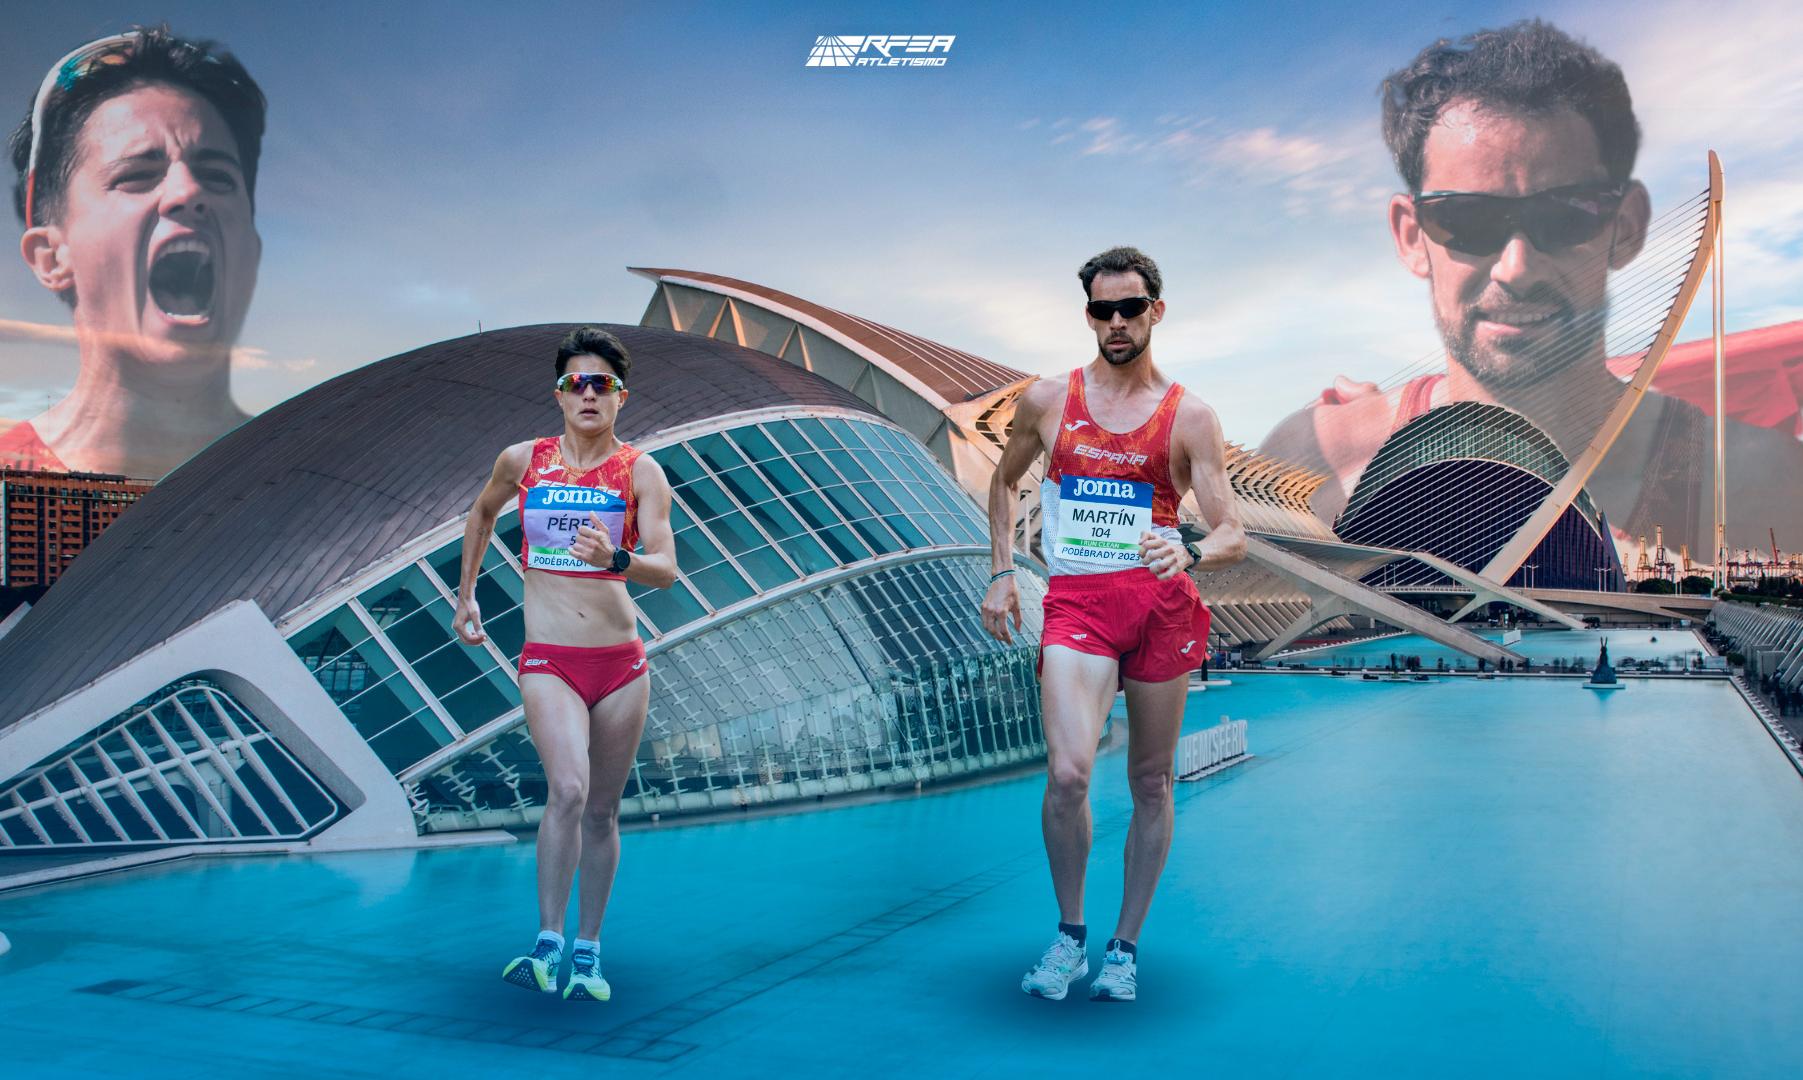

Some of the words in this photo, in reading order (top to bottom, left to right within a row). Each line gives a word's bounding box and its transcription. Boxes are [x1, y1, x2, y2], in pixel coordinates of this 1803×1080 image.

[1073, 444, 1148, 465] ESPAÑA
[547, 514, 602, 531] PÉRE
[1072, 508, 1136, 527] MARTÍN
[1091, 527, 1111, 539] 104
[1098, 541, 1120, 549] CLEAN
[1117, 552, 1141, 561] 2023
